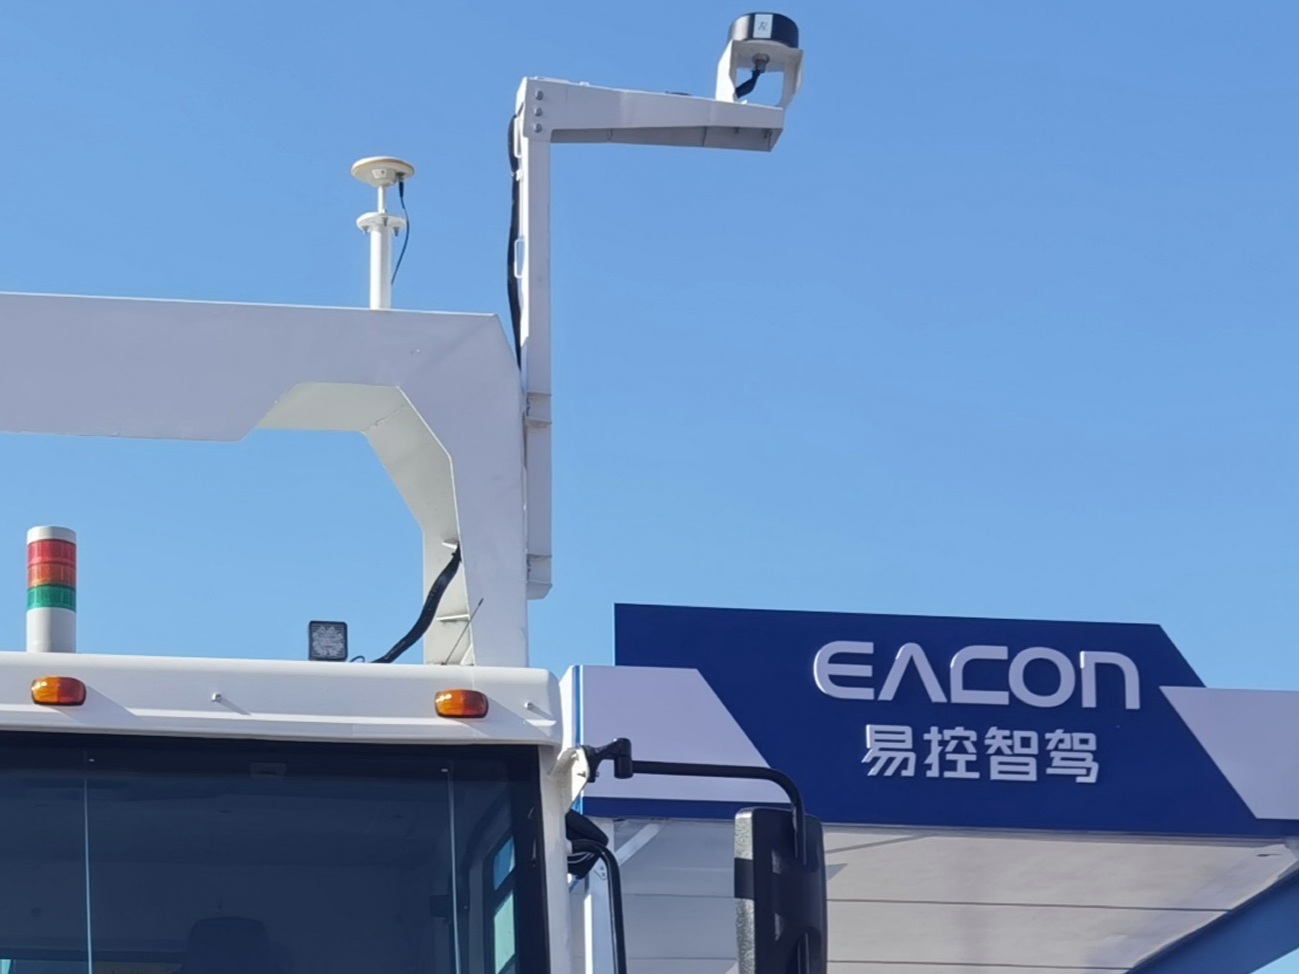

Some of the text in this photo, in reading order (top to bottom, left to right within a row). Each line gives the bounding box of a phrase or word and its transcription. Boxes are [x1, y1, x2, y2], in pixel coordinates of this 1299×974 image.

[813, 640, 1141, 710] EACON
[861, 724, 1099, 783] 易控智驾
